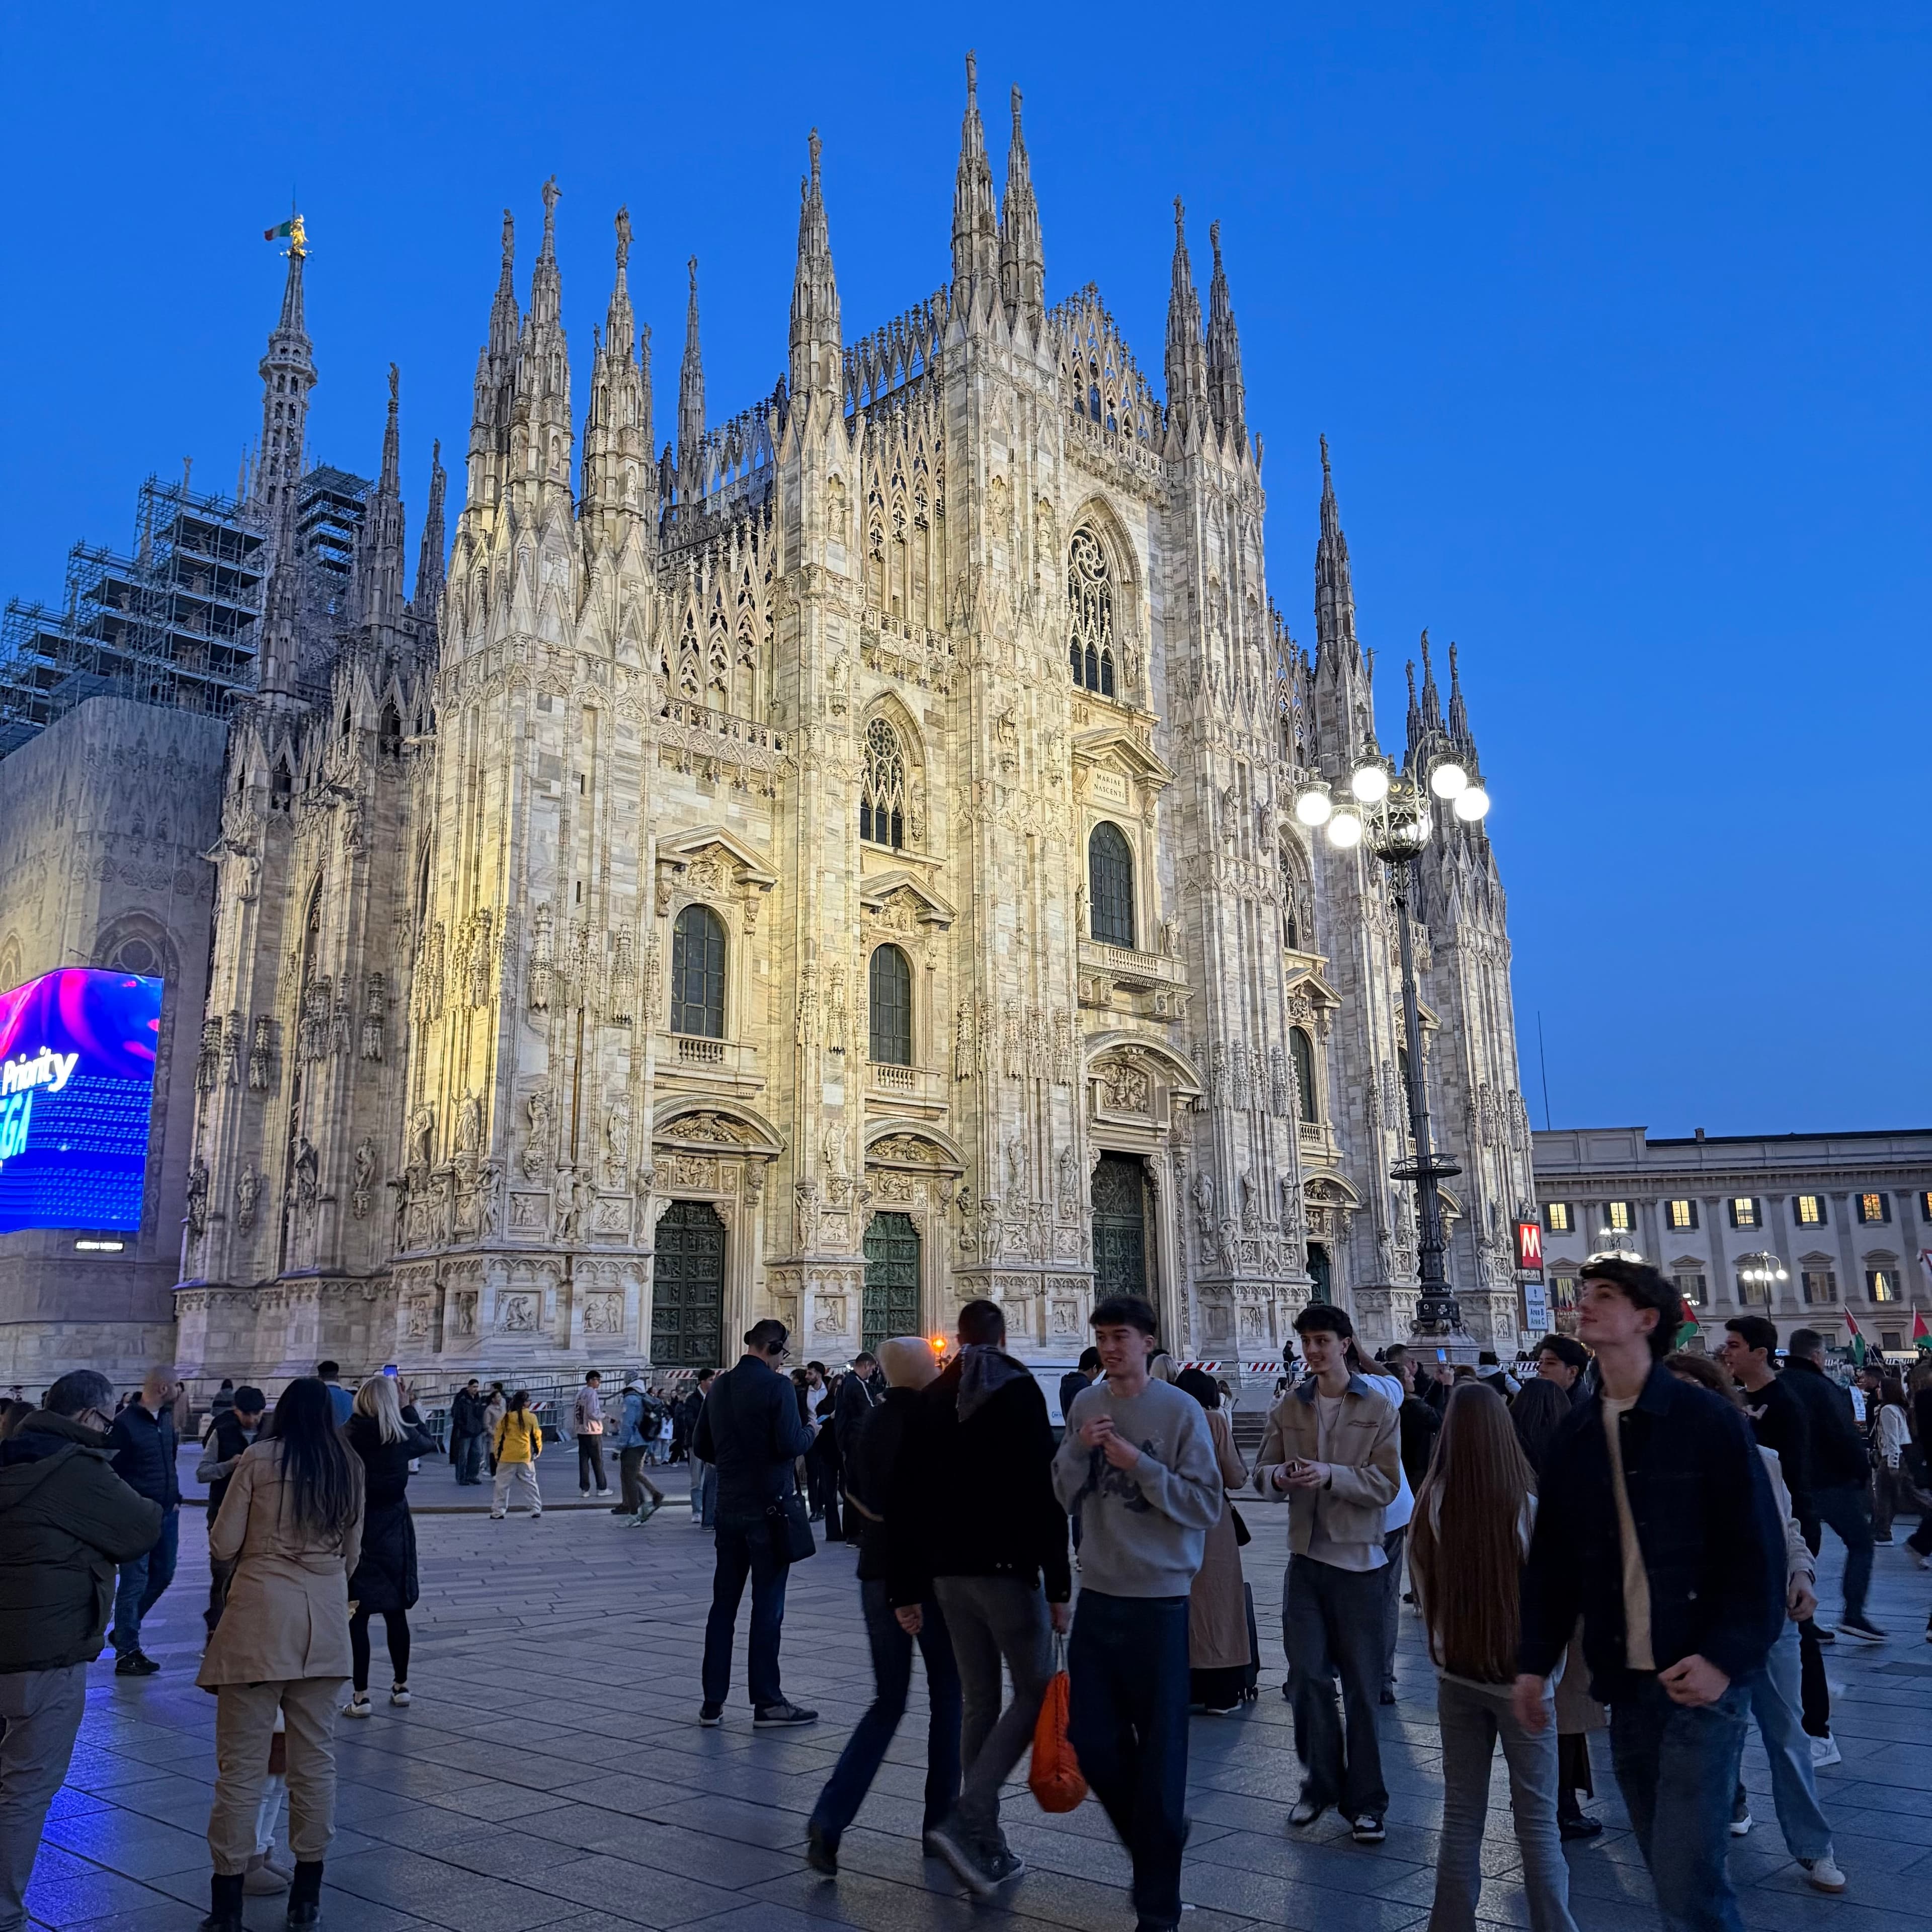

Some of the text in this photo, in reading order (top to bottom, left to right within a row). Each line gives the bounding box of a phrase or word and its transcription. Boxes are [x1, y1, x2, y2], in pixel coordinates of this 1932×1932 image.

[1094, 783, 1124, 798] NASCENTI
[1097, 773, 1120, 786] MARIAE
[2, 1045, 79, 1096] Priority
[1522, 1228, 1542, 1258] M
